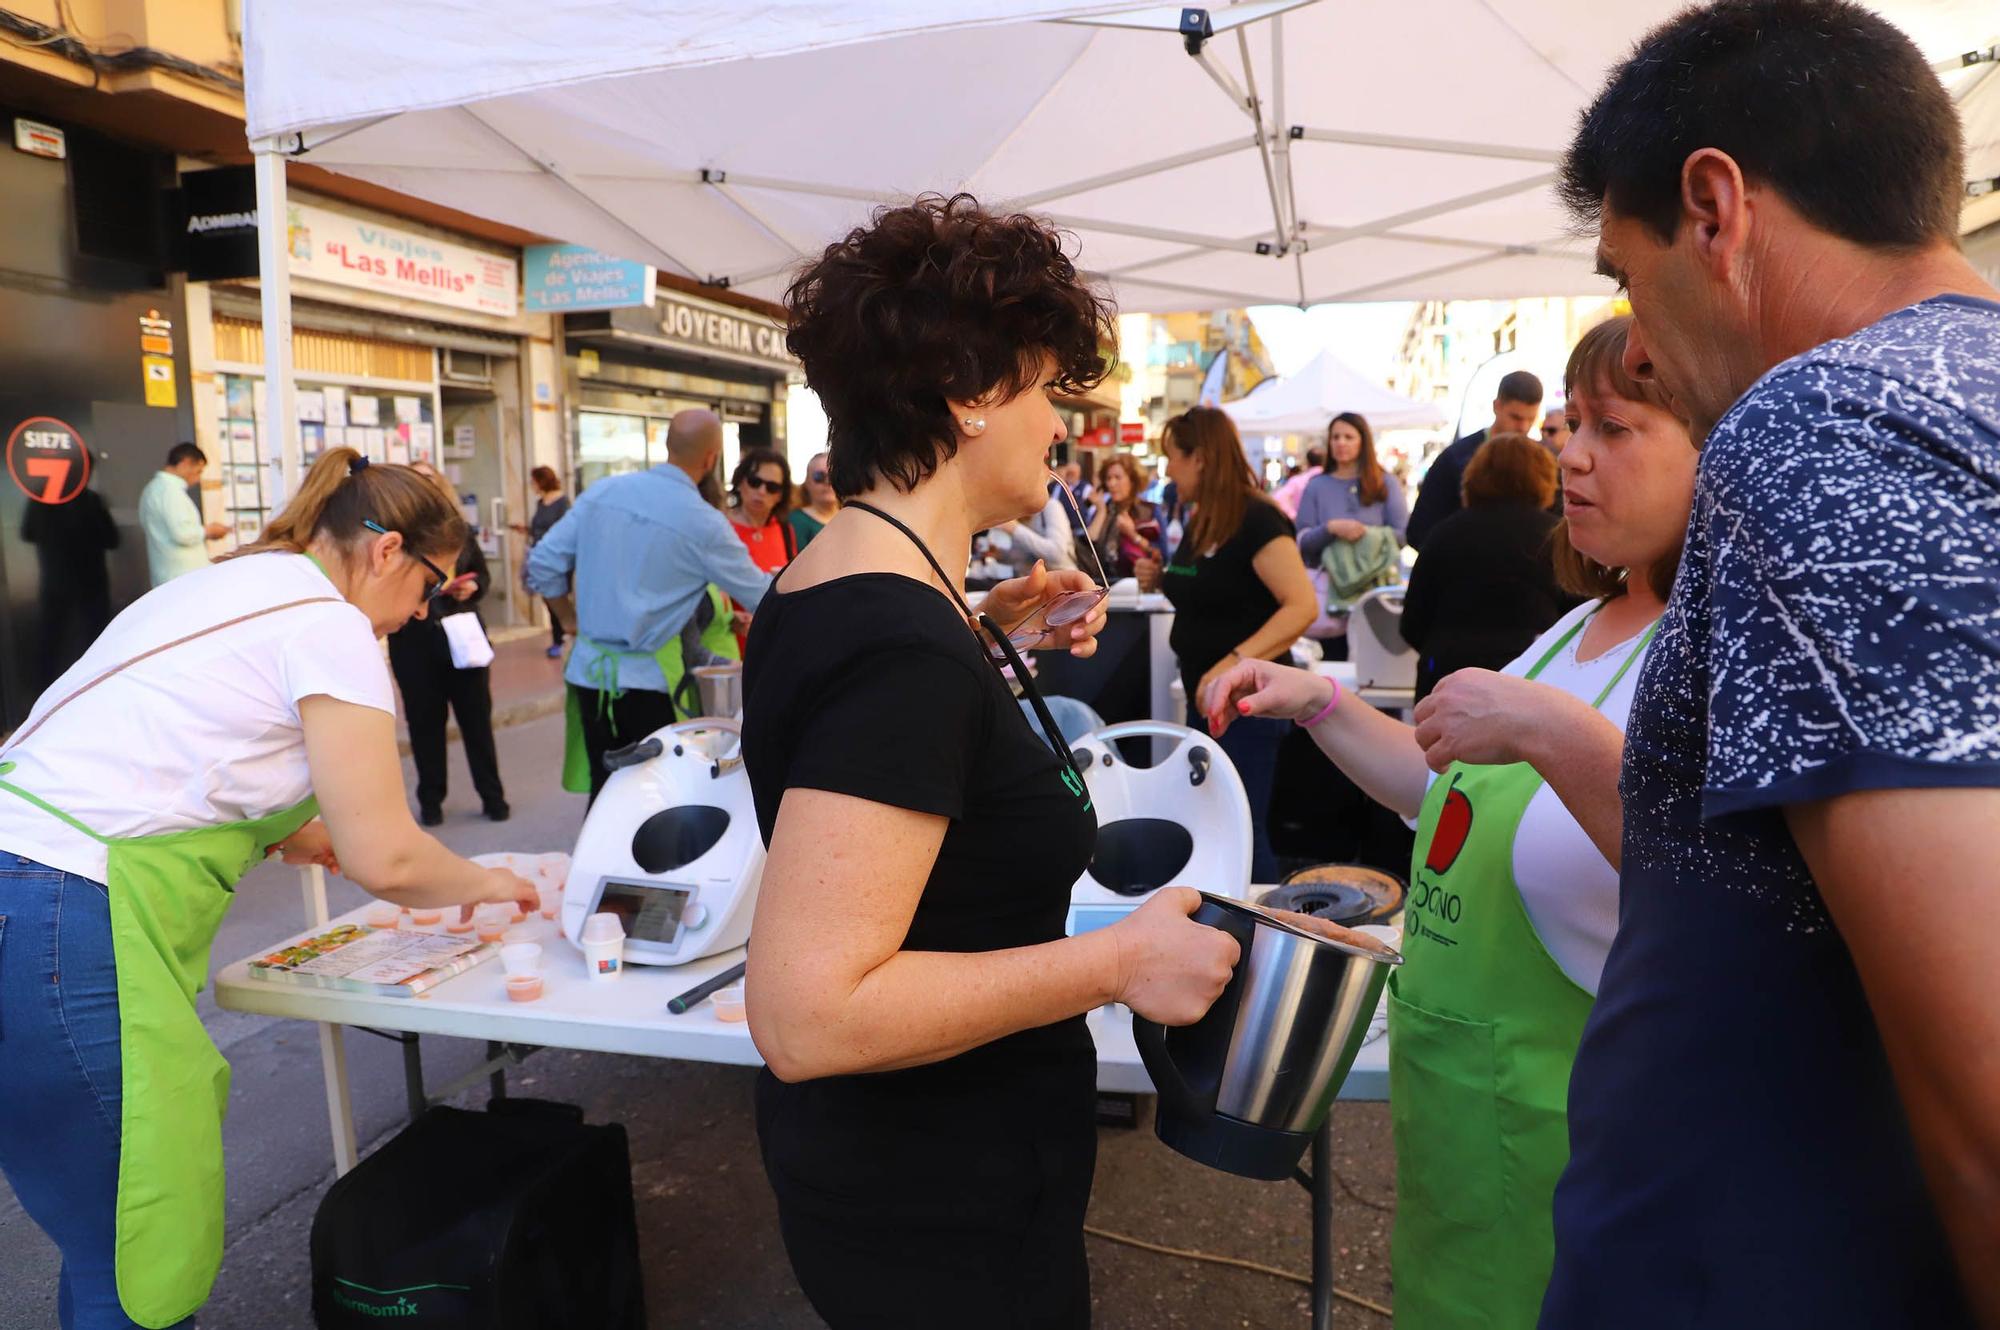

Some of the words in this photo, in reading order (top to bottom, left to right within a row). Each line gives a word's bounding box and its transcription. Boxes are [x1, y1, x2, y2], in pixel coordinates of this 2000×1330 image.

[357, 225, 443, 262] Viajes
[661, 303, 753, 352] JOYERIA
[333, 1287, 418, 1317] rmomix
